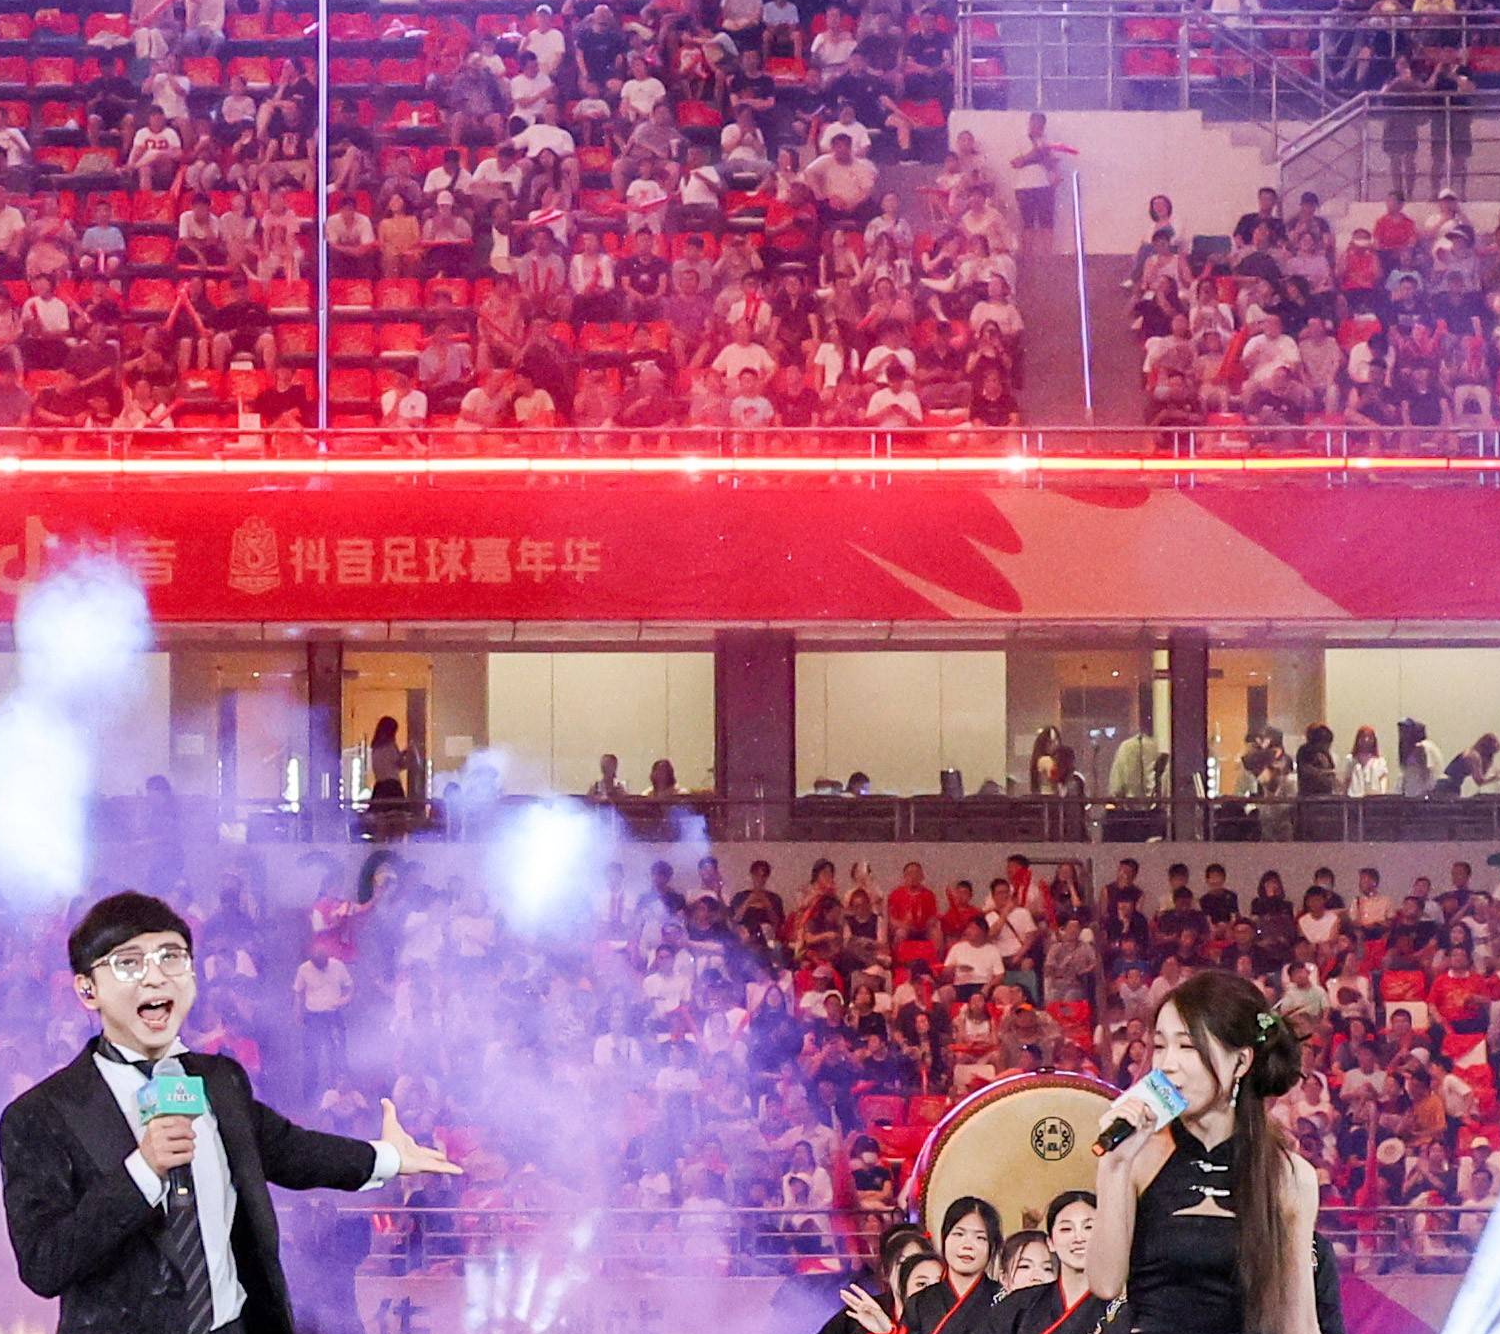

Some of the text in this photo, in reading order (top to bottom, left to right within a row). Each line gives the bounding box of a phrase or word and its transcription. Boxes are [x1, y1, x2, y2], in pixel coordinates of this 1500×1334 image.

[289, 536, 601, 585] 抖音足球嘉年华
